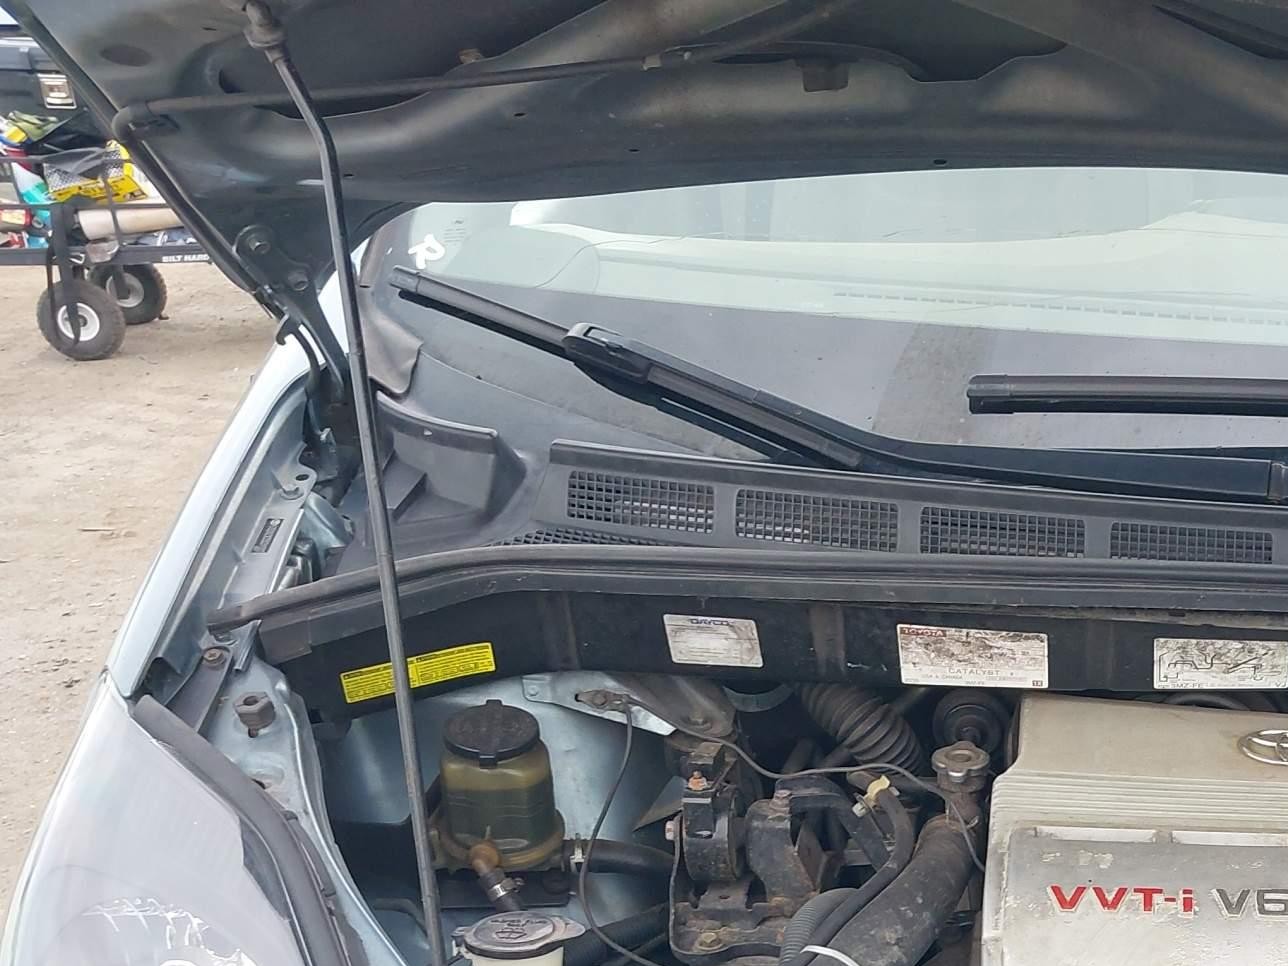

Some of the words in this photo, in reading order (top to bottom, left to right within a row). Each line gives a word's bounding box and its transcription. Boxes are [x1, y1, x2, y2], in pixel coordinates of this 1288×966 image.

[902, 627, 944, 637] TOYOTA
[948, 667, 1001, 676] CATALYST
[1049, 884, 1196, 914] VVT-i
